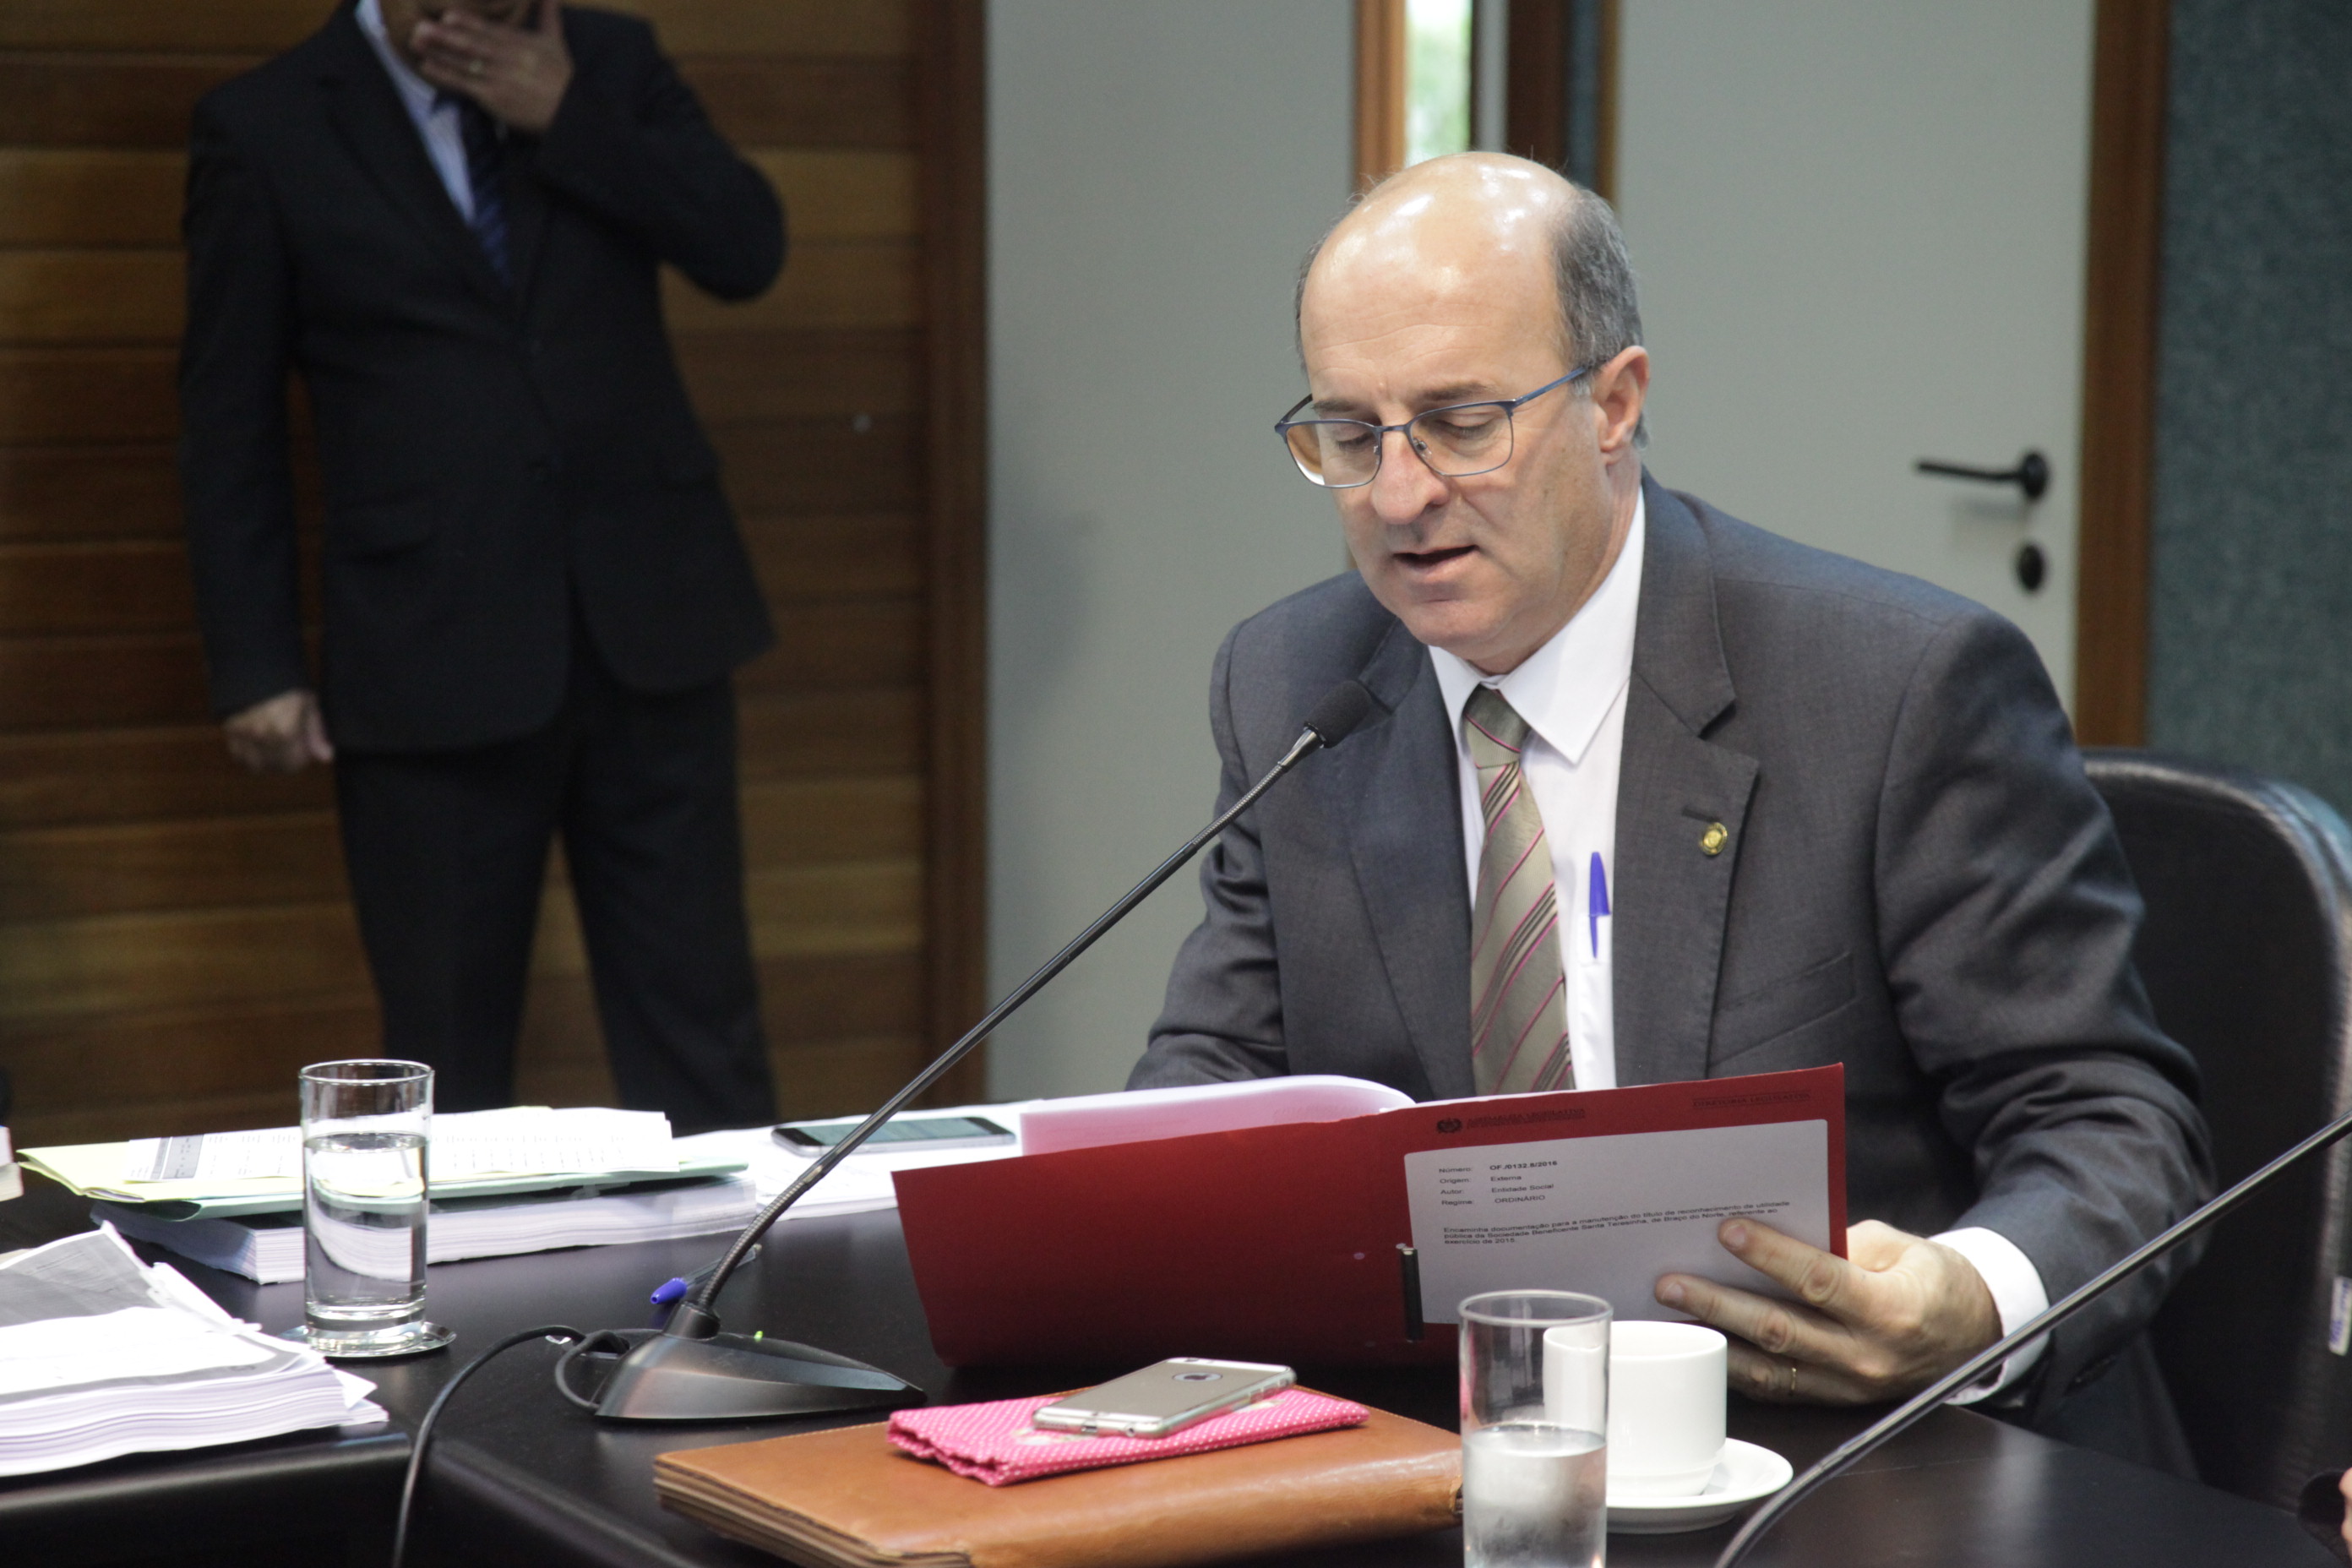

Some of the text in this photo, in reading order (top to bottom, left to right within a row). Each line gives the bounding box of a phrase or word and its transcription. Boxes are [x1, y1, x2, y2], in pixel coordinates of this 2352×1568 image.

[1529, 1183, 1554, 1191] Social
[1494, 1194, 1546, 1204] ORDINÁRIO
[1490, 1223, 1549, 1232] documentação
[1579, 1214, 1629, 1224] manutenção
[1677, 1204, 1742, 1214] reconhecimento
[1756, 1200, 1790, 1209] utilidade
